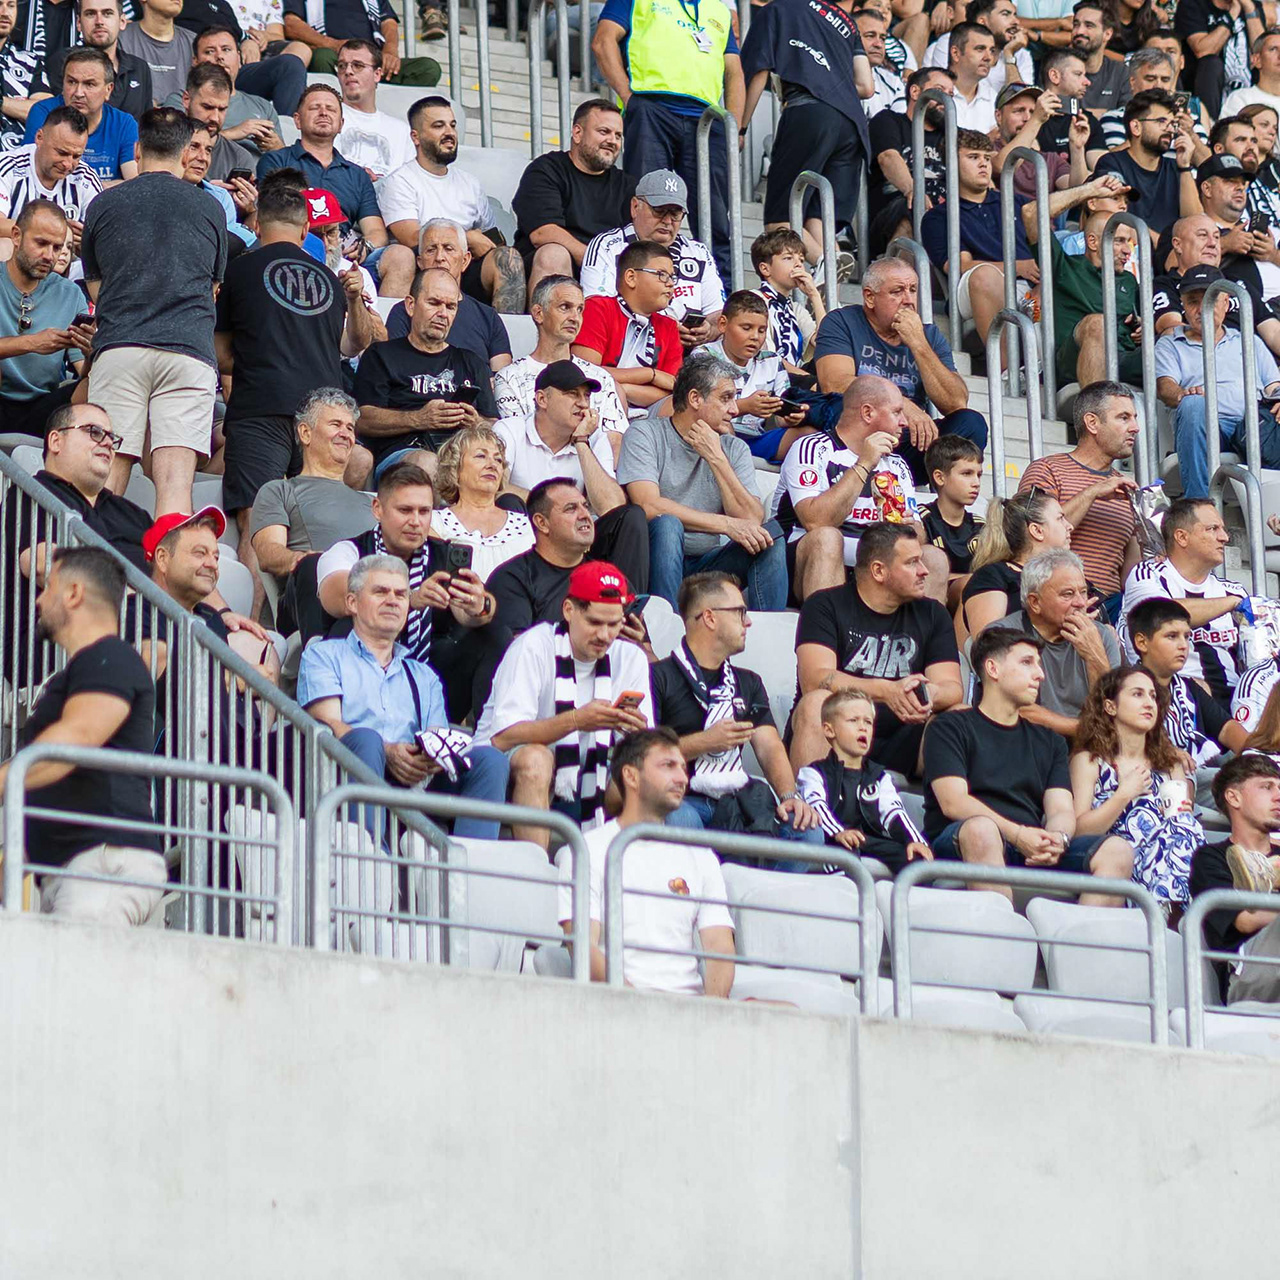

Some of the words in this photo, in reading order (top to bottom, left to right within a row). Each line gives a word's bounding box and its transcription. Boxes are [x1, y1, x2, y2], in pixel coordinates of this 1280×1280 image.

[809, 0, 842, 30] Mobil
[665, 177, 678, 192] NY
[861, 344, 919, 371] DENIM
[1191, 627, 1238, 645] ERBET
